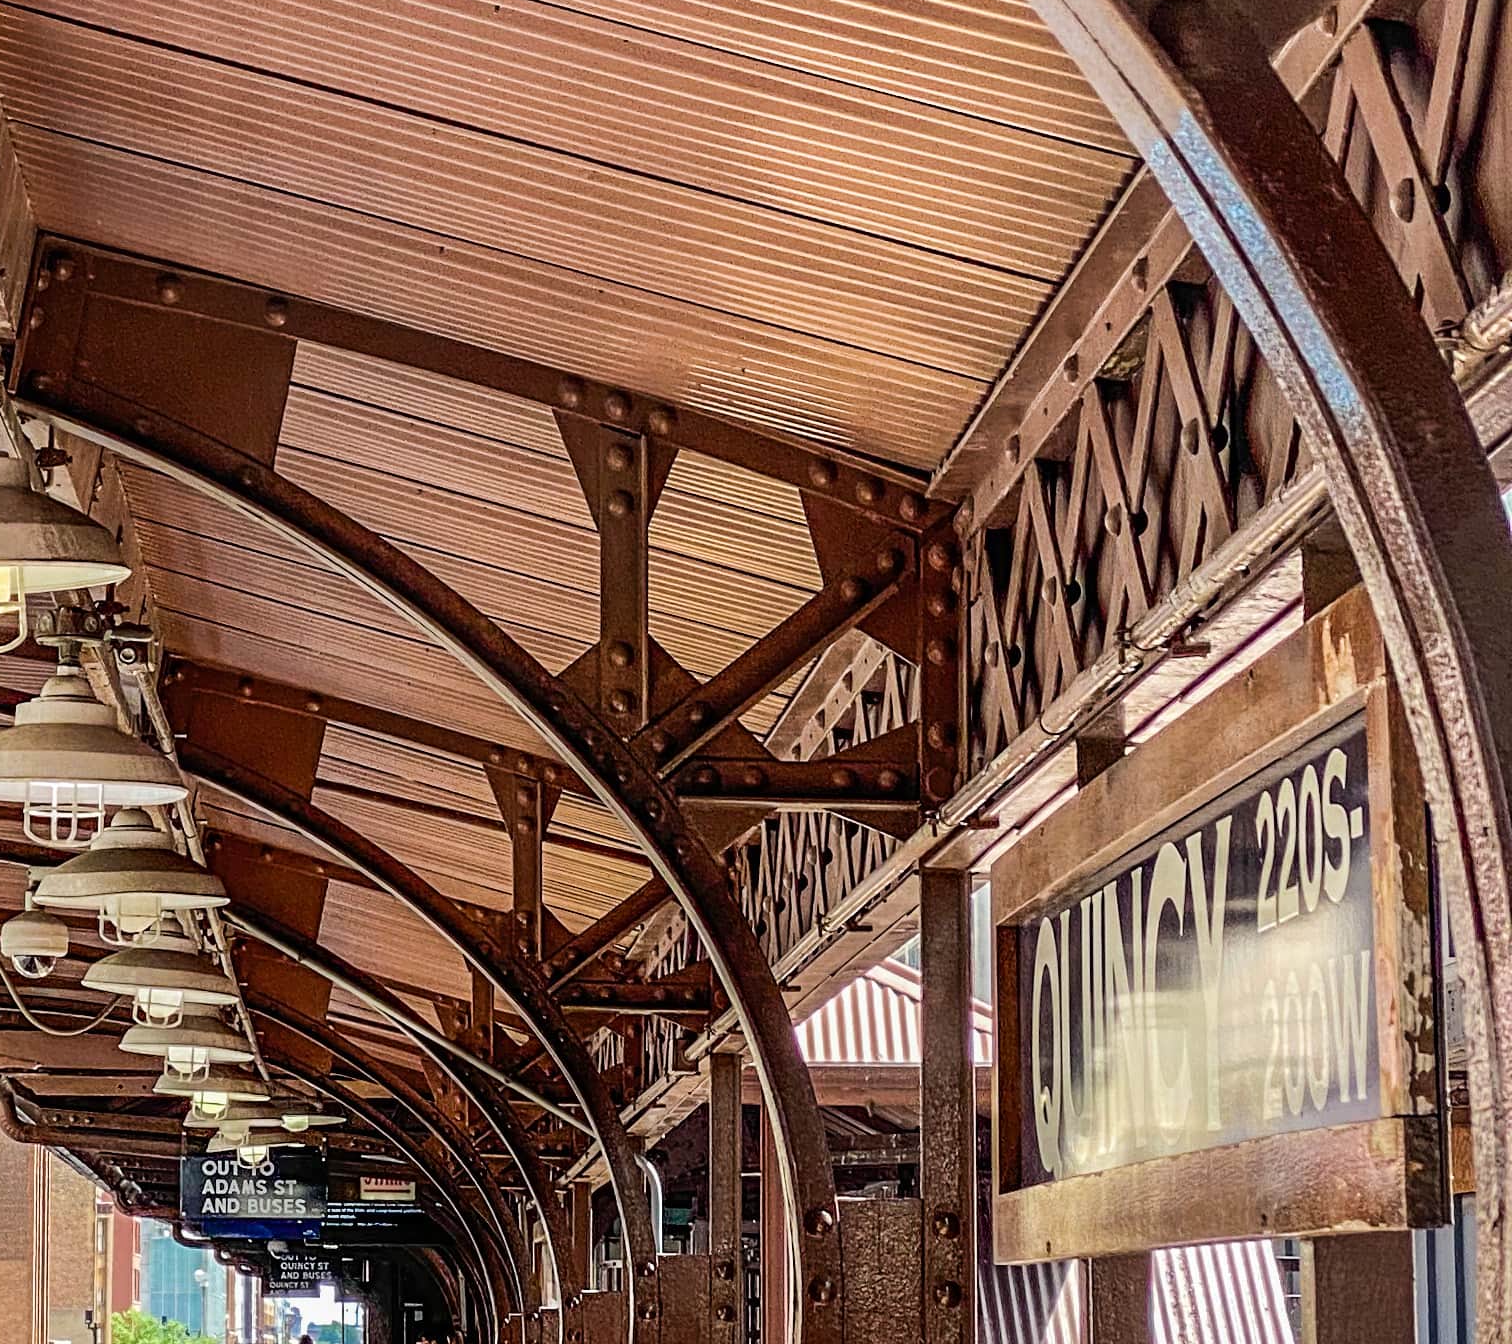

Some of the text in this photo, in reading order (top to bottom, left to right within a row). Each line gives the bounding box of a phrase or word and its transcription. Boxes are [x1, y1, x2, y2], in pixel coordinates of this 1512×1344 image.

[1032, 815, 1232, 1177] QUINCY
[202, 1160, 238, 1176] OUT
[202, 1179, 297, 1195] ADAMS ST
[202, 1198, 306, 1214] AND BUSES
[281, 1262, 329, 1270] QUINCY ST
[303, 1272, 332, 1280] BUSES
